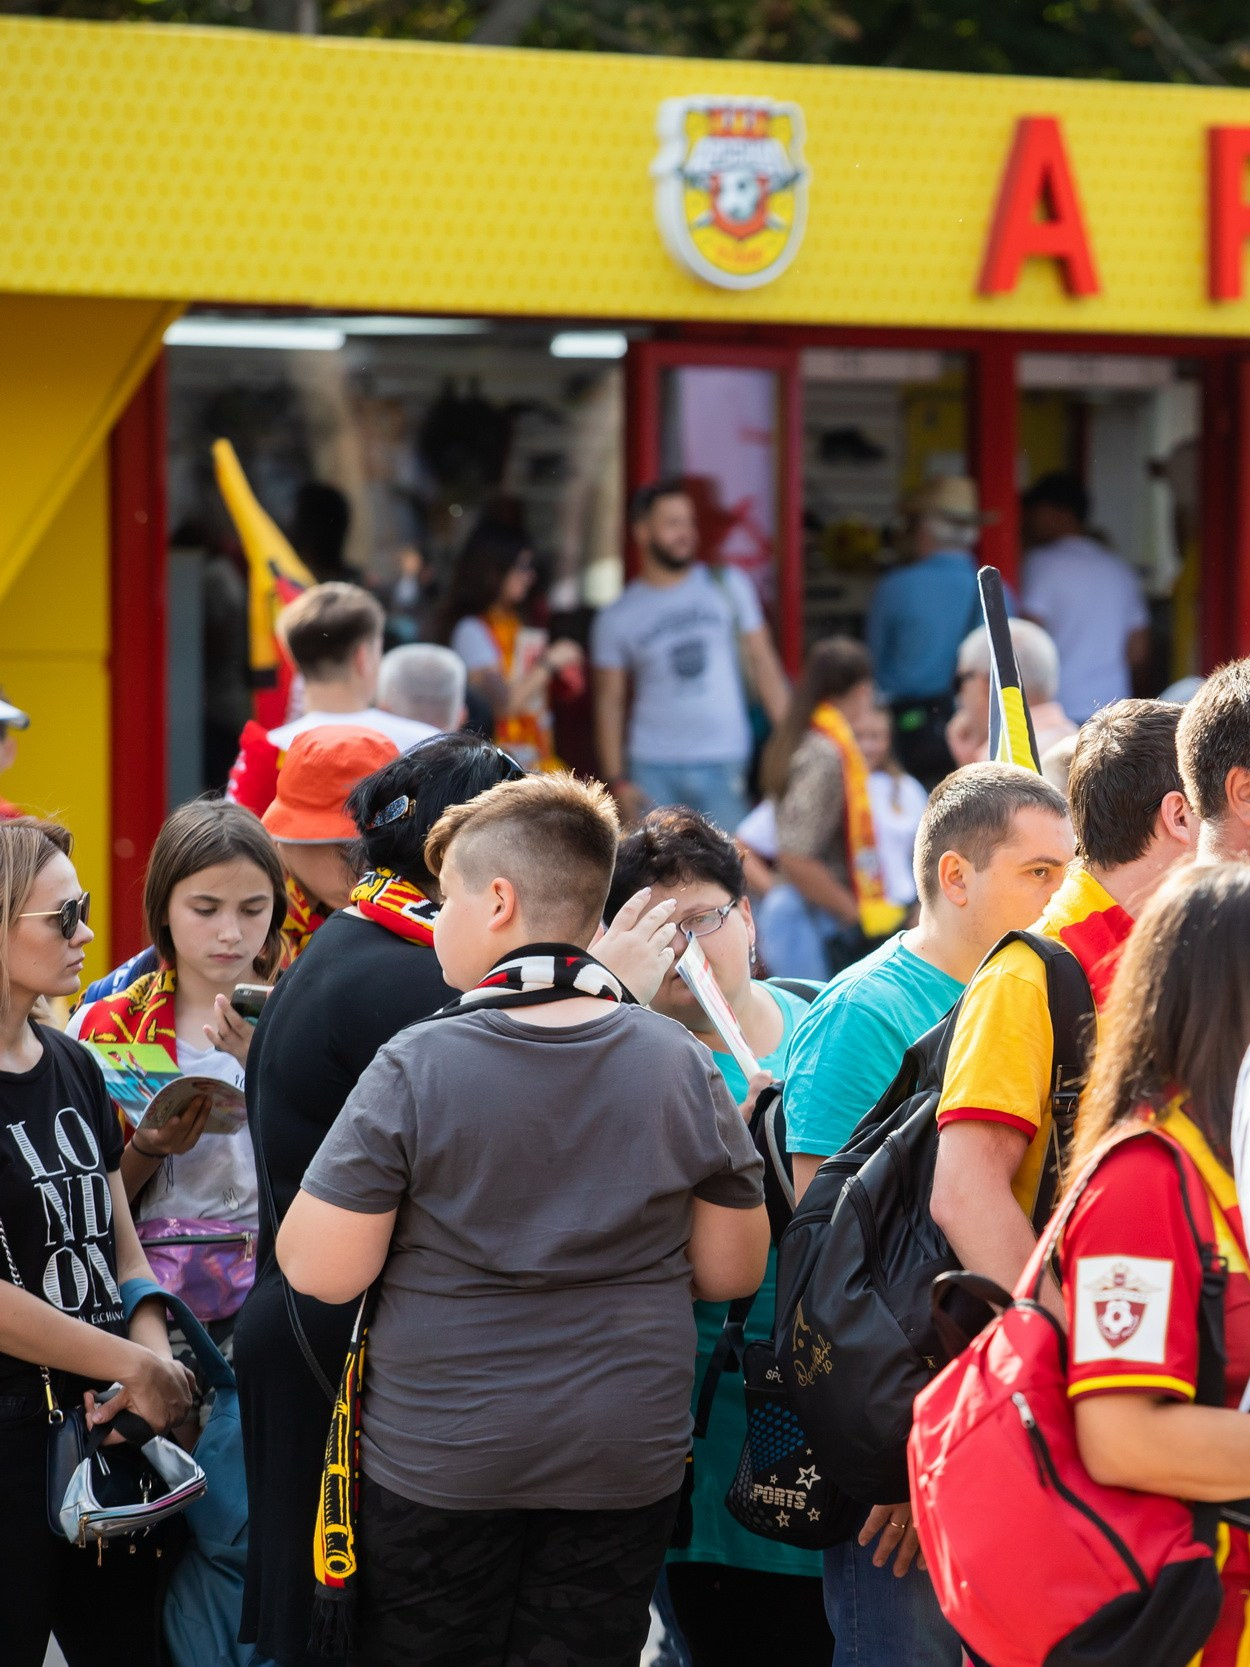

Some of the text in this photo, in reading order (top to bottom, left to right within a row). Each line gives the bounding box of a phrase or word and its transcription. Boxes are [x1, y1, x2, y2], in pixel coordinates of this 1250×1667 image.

[6, 1106, 100, 1181] LO
[33, 1172, 113, 1247] ND
[42, 1242, 123, 1312] ON
[750, 1483, 807, 1510] PORTS
